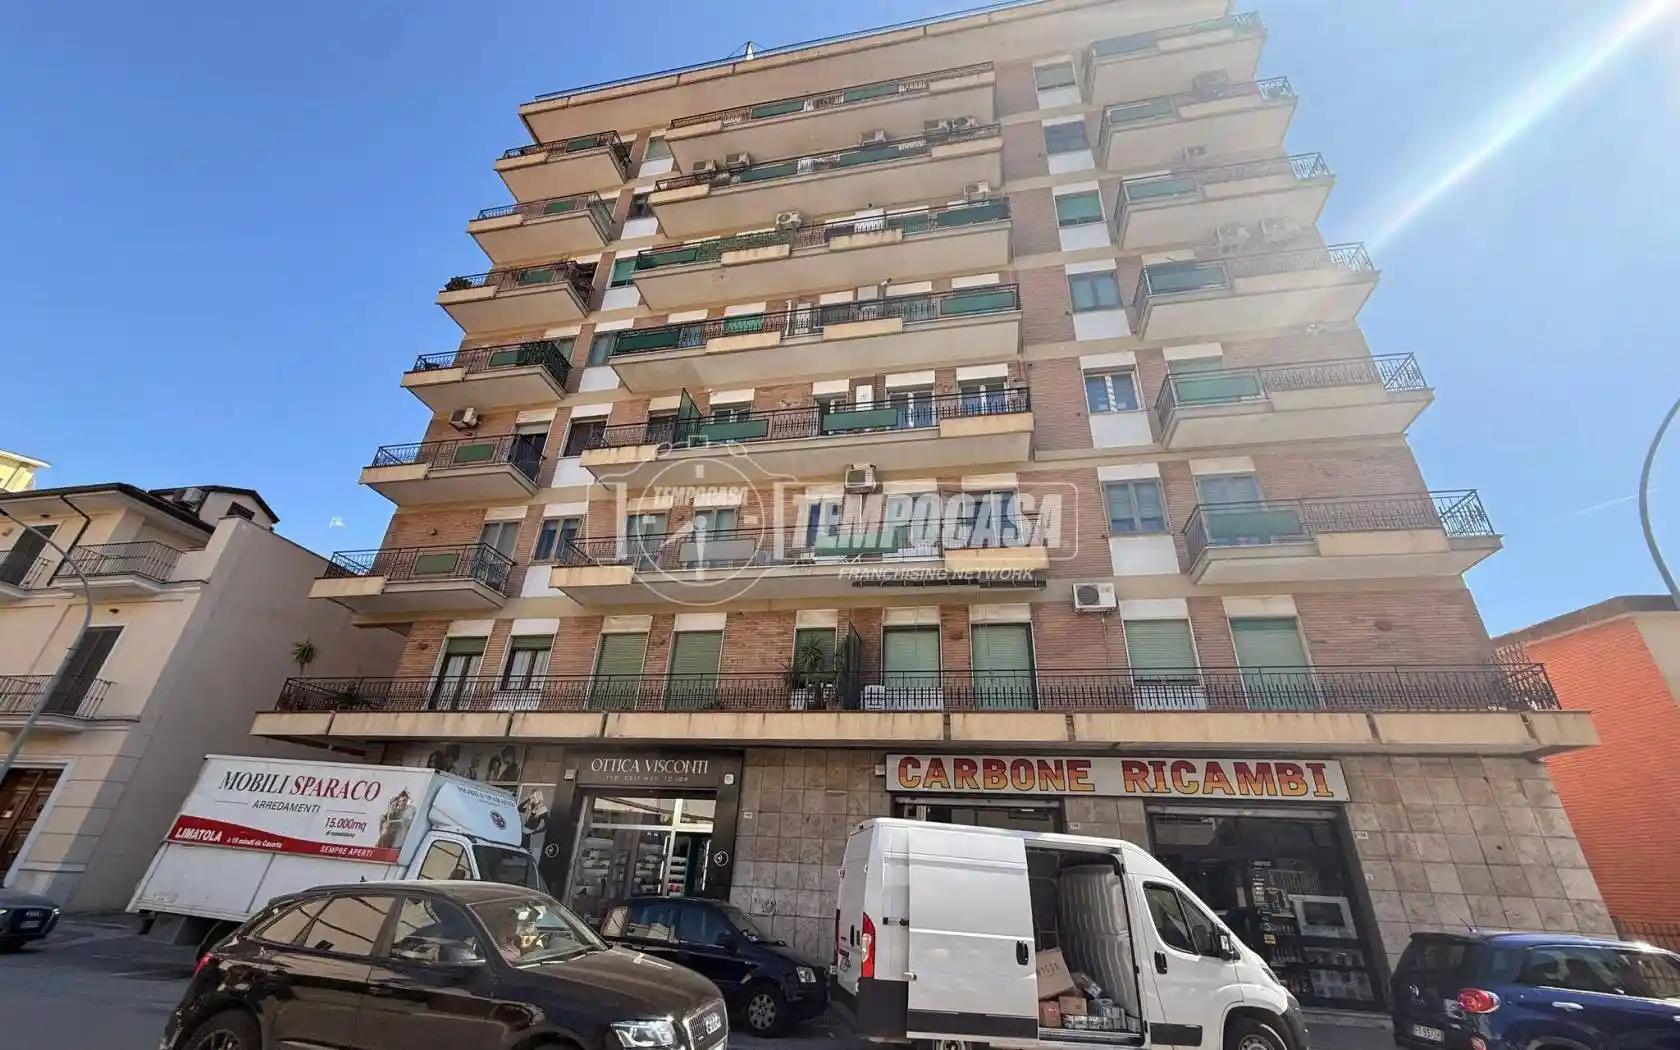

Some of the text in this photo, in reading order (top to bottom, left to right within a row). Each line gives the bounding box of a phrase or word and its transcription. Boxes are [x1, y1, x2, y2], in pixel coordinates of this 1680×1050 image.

[591, 758, 709, 774] OTTICA VISCONTI
[897, 755, 1335, 798] CARBONE RICAMBI
[219, 771, 381, 801] MOBILI SPARACO
[252, 800, 321, 814] ARREDAMENTI
[325, 817, 367, 832] 15.000mq
[175, 827, 223, 842] LIMATOLA
[320, 845, 374, 857] SEMPRE APERTI
